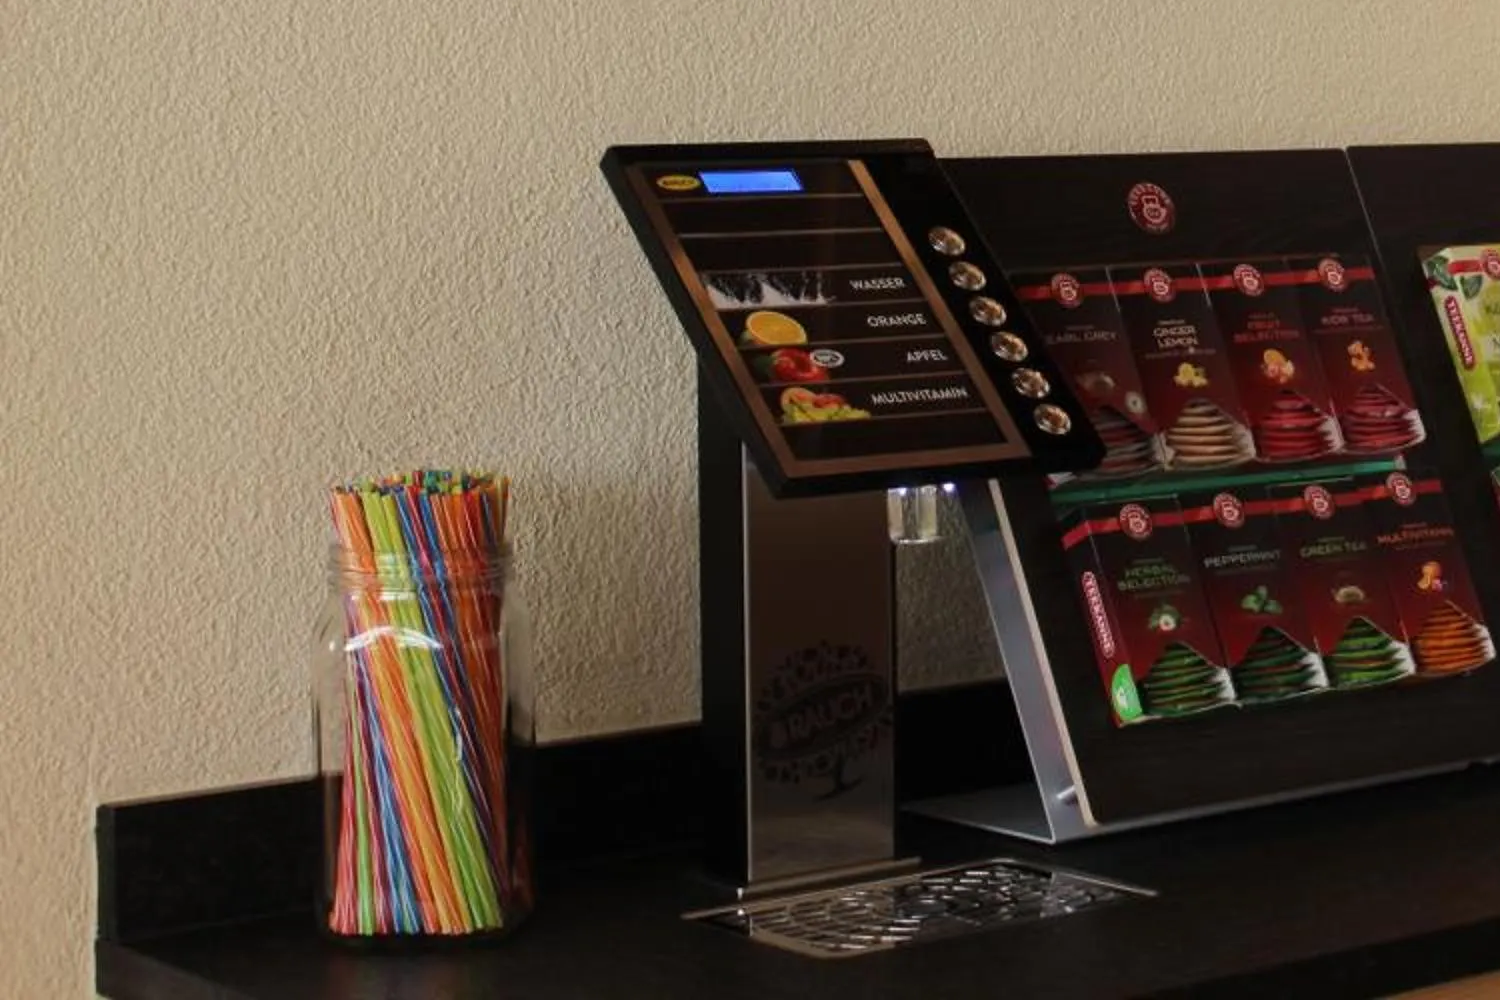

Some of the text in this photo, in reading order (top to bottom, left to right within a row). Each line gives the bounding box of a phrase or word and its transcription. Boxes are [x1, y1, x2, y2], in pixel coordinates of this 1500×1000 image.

[849, 277, 905, 291] WASSER
[867, 313, 927, 327] ORANGE
[1156, 337, 1200, 350] LEMON
[907, 349, 948, 362] APFEL
[871, 387, 969, 405] MULTIVITAMIN
[1300, 543, 1343, 558] GREEN
[1204, 549, 1281, 569] PEPPERMINT
[788, 684, 874, 740] RAUCH
